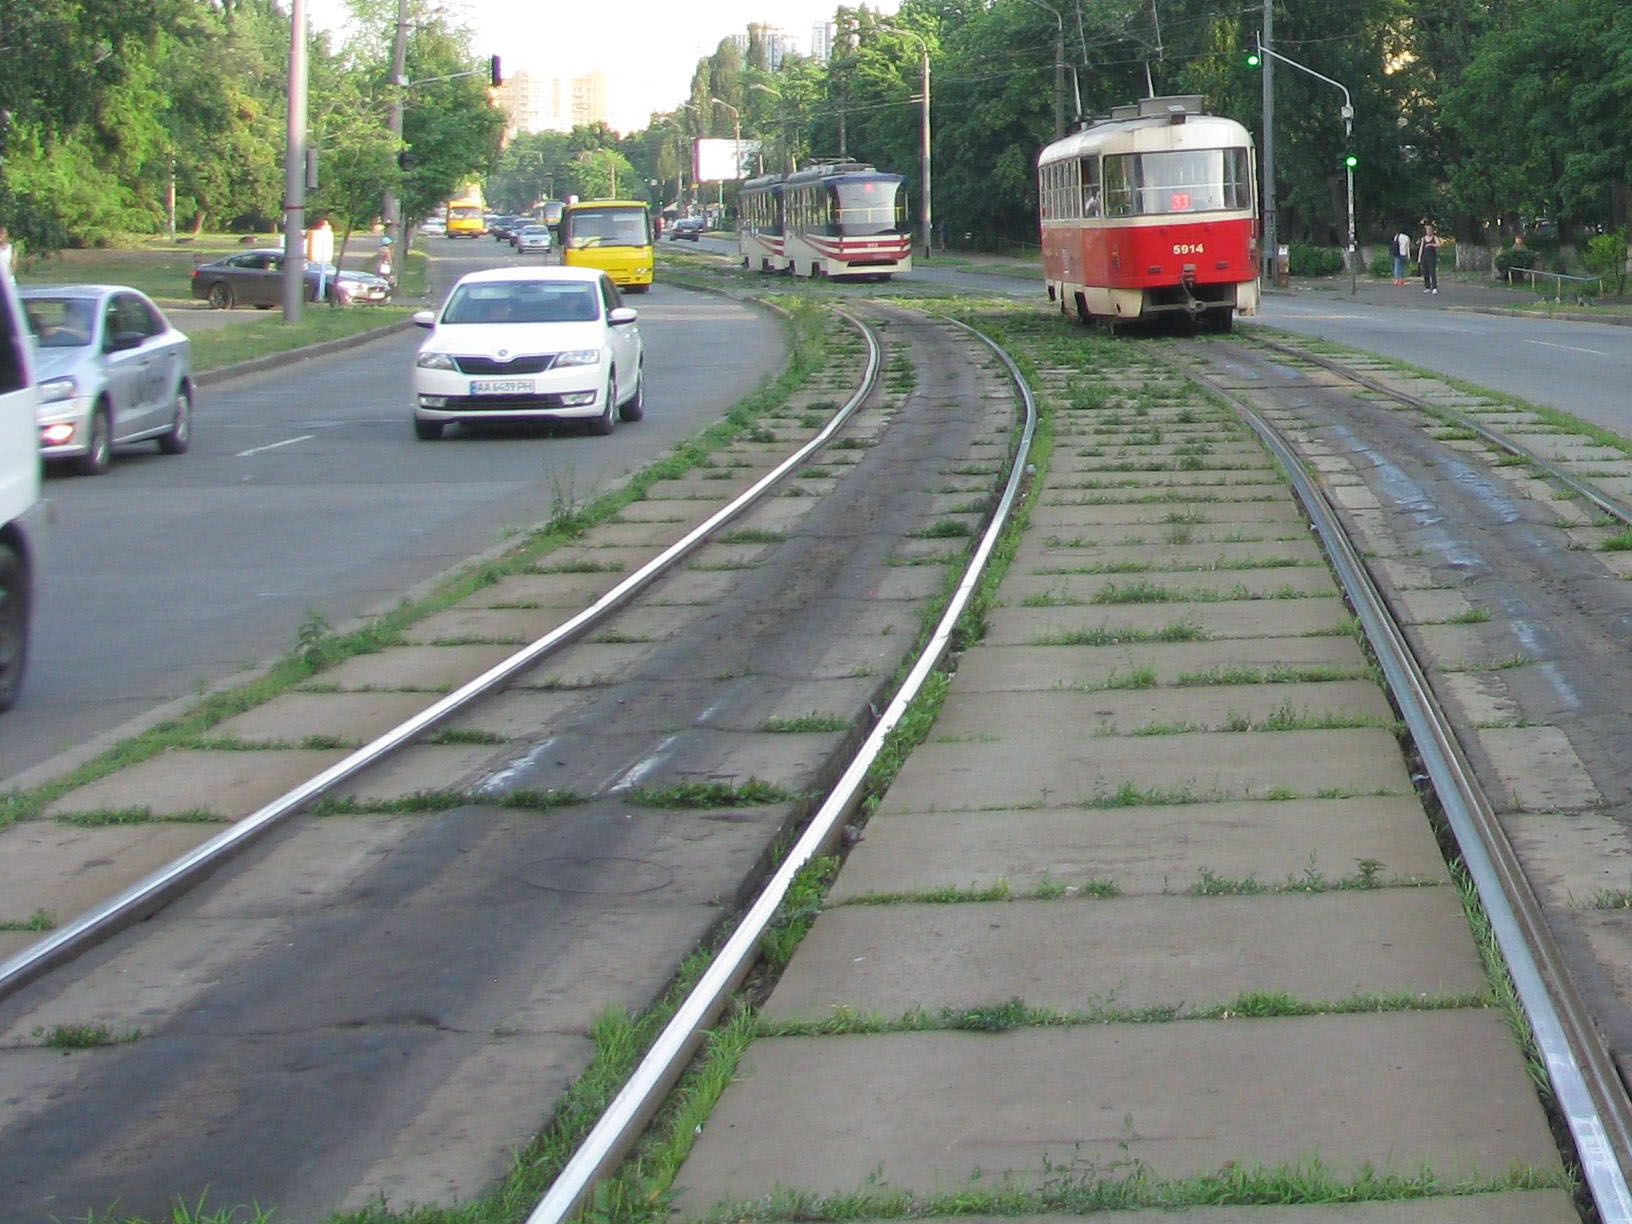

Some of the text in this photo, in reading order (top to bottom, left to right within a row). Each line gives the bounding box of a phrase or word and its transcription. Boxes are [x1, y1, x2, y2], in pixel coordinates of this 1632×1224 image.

[1171, 193, 1189, 210] 33
[1173, 243, 1204, 255] 5914
[477, 382, 491, 392] AA
